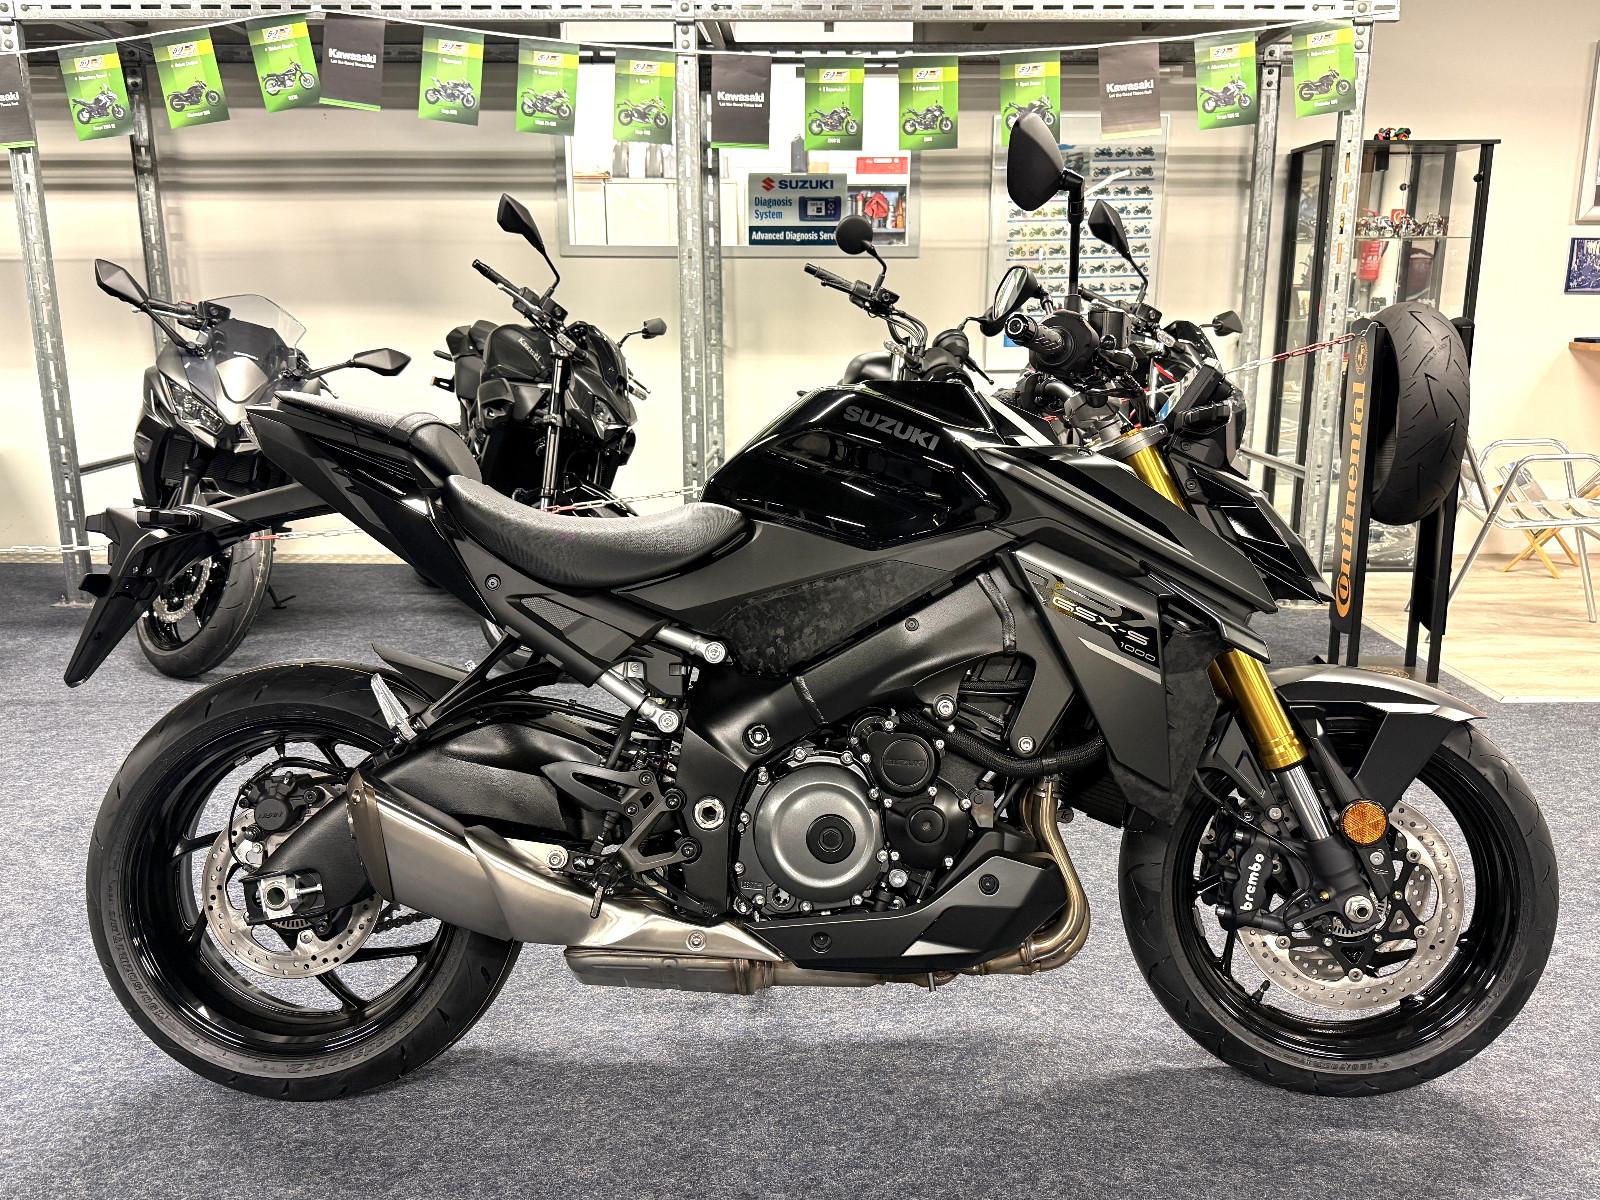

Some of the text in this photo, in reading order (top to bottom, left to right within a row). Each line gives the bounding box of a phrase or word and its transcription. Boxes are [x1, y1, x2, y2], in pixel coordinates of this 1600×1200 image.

[328, 48, 377, 63] Kawasaki
[1106, 79, 1154, 93] Kawasaki
[717, 90, 765, 103] Kawasaki
[778, 179, 834, 190] SUZUKI
[754, 196, 793, 208] Diagnosis
[754, 209, 783, 220] System
[751, 231, 784, 240] Advanced
[785, 231, 818, 242] Diagnosis
[843, 405, 941, 451] SUZUKI
[1120, 641, 1156, 662] 1000
[1239, 852, 1265, 911] brembo
